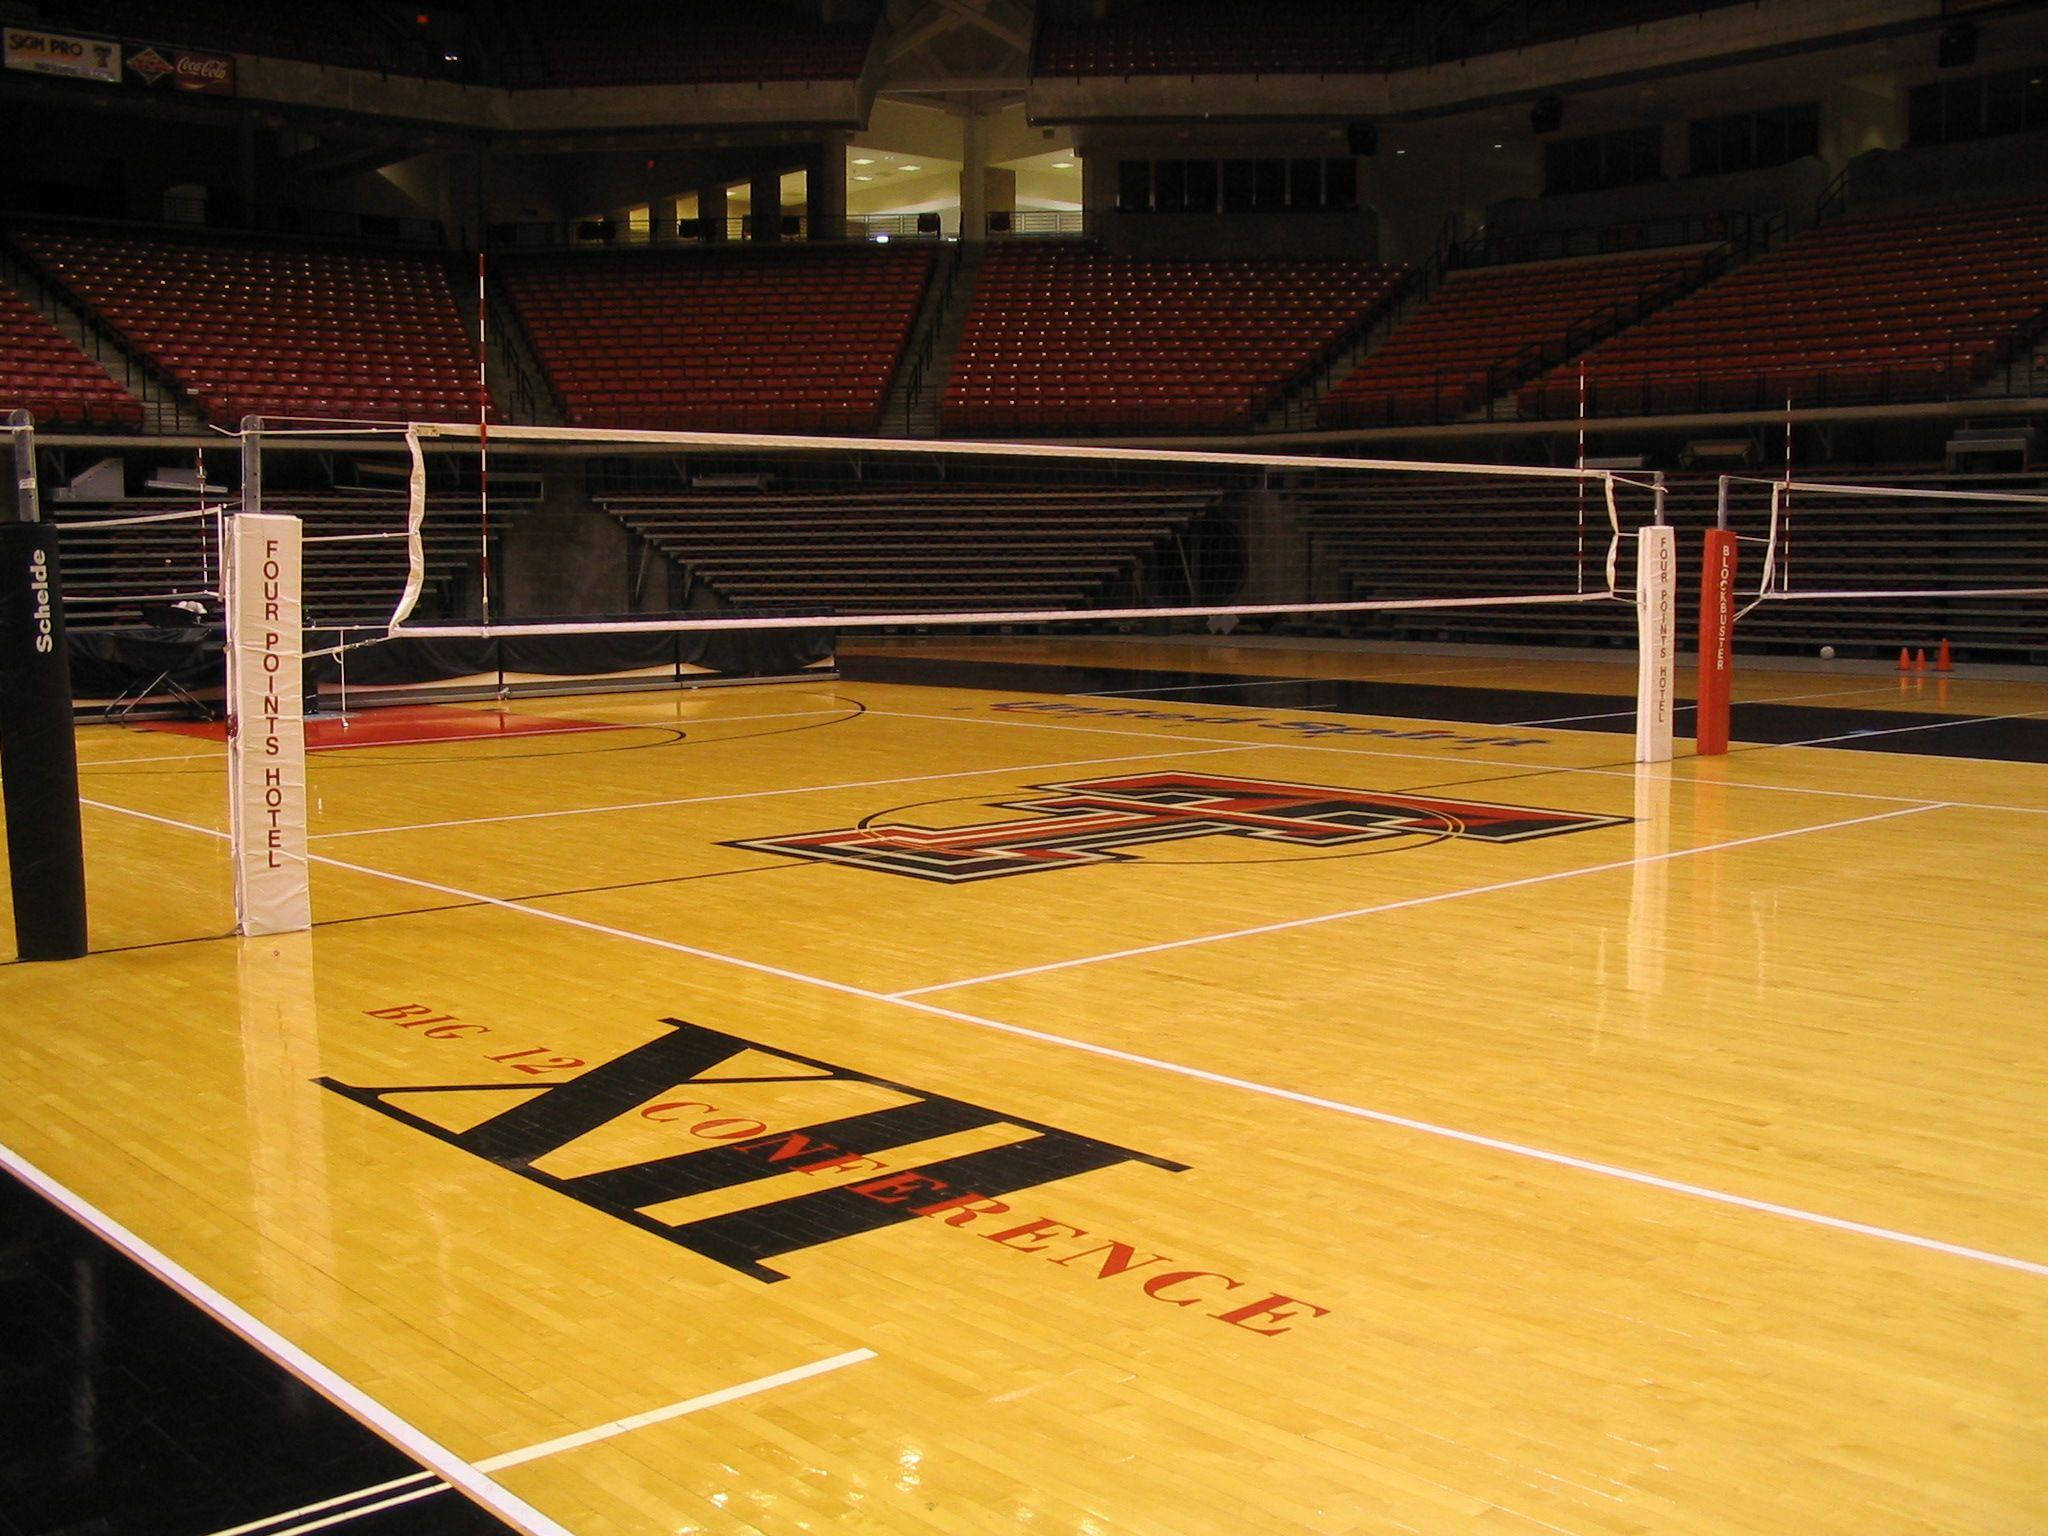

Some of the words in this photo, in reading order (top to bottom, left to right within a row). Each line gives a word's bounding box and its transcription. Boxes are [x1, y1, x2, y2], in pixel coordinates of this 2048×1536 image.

[51, 39, 83, 56] PRO
[29, 548, 53, 654] Schelde
[263, 540, 279, 621] FOUR
[1660, 537, 1669, 583] FOUR
[1660, 589, 1668, 658] POINTS
[1717, 545, 1730, 670] BLOCKBUSTER
[263, 633, 279, 756] POINTS
[1658, 666, 1667, 723] HOTEL
[265, 767, 282, 868] HOTEL
[361, 1002, 493, 1040] BIG
[483, 1046, 587, 1076] 12
[310, 1017, 1191, 1284] XII
[640, 1101, 1332, 1337] CONFERENCE
